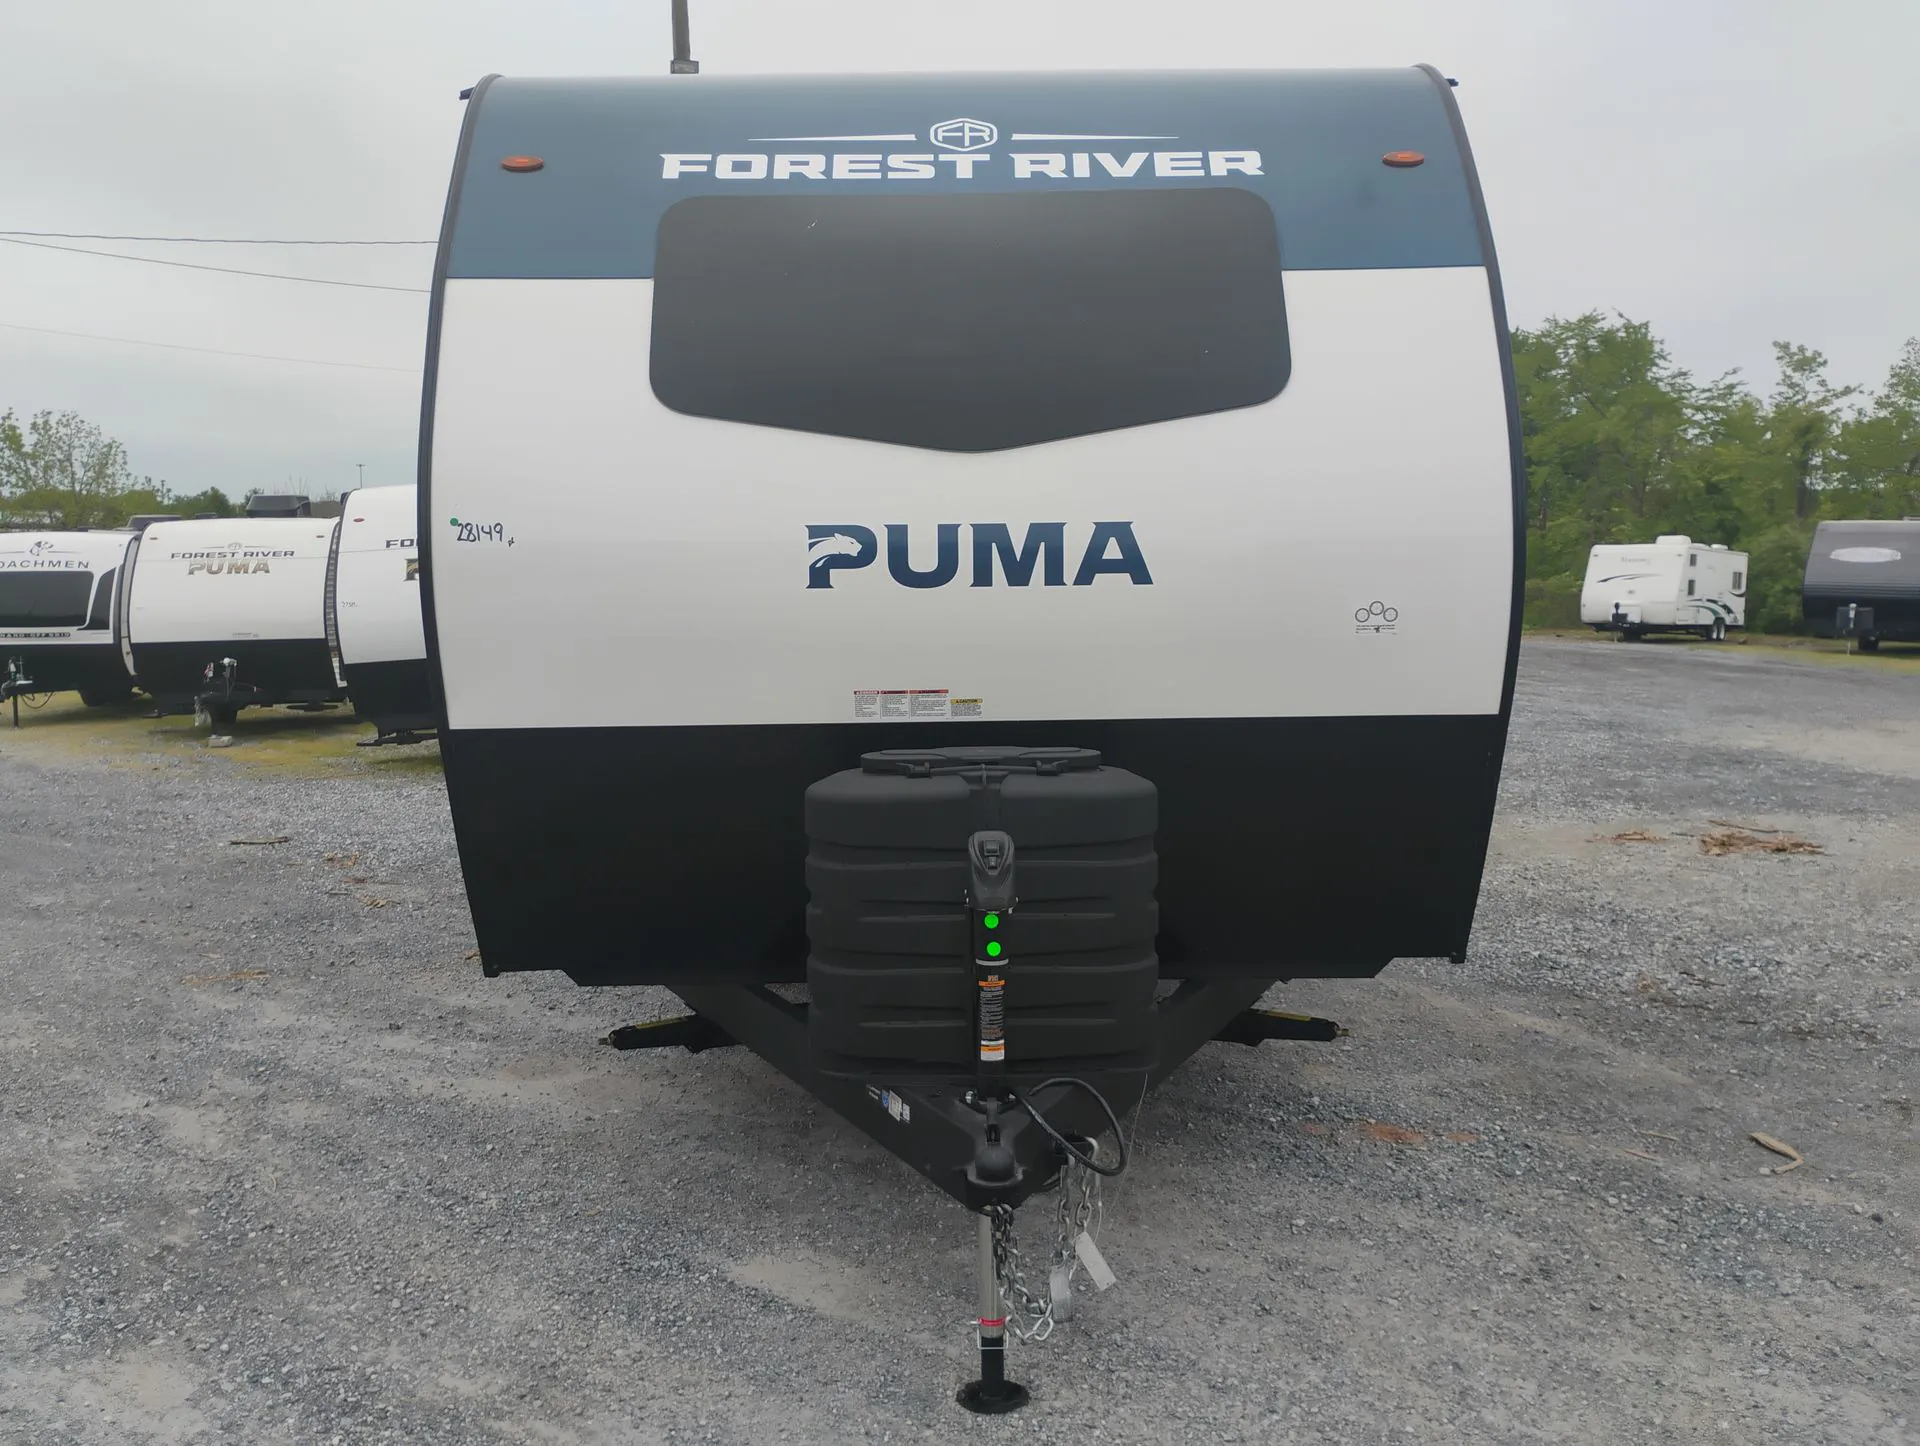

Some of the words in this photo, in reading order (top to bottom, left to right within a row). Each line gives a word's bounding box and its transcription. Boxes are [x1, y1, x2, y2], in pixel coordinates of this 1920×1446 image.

[937, 121, 991, 148] FR
[659, 152, 991, 180] FOREST
[1011, 150, 1265, 179] RIVER
[456, 522, 504, 543] 28149
[170, 551, 239, 559] FOREST
[243, 550, 296, 558] RIVER
[803, 521, 1155, 589] PUMA
[187, 559, 271, 576] PUMA
